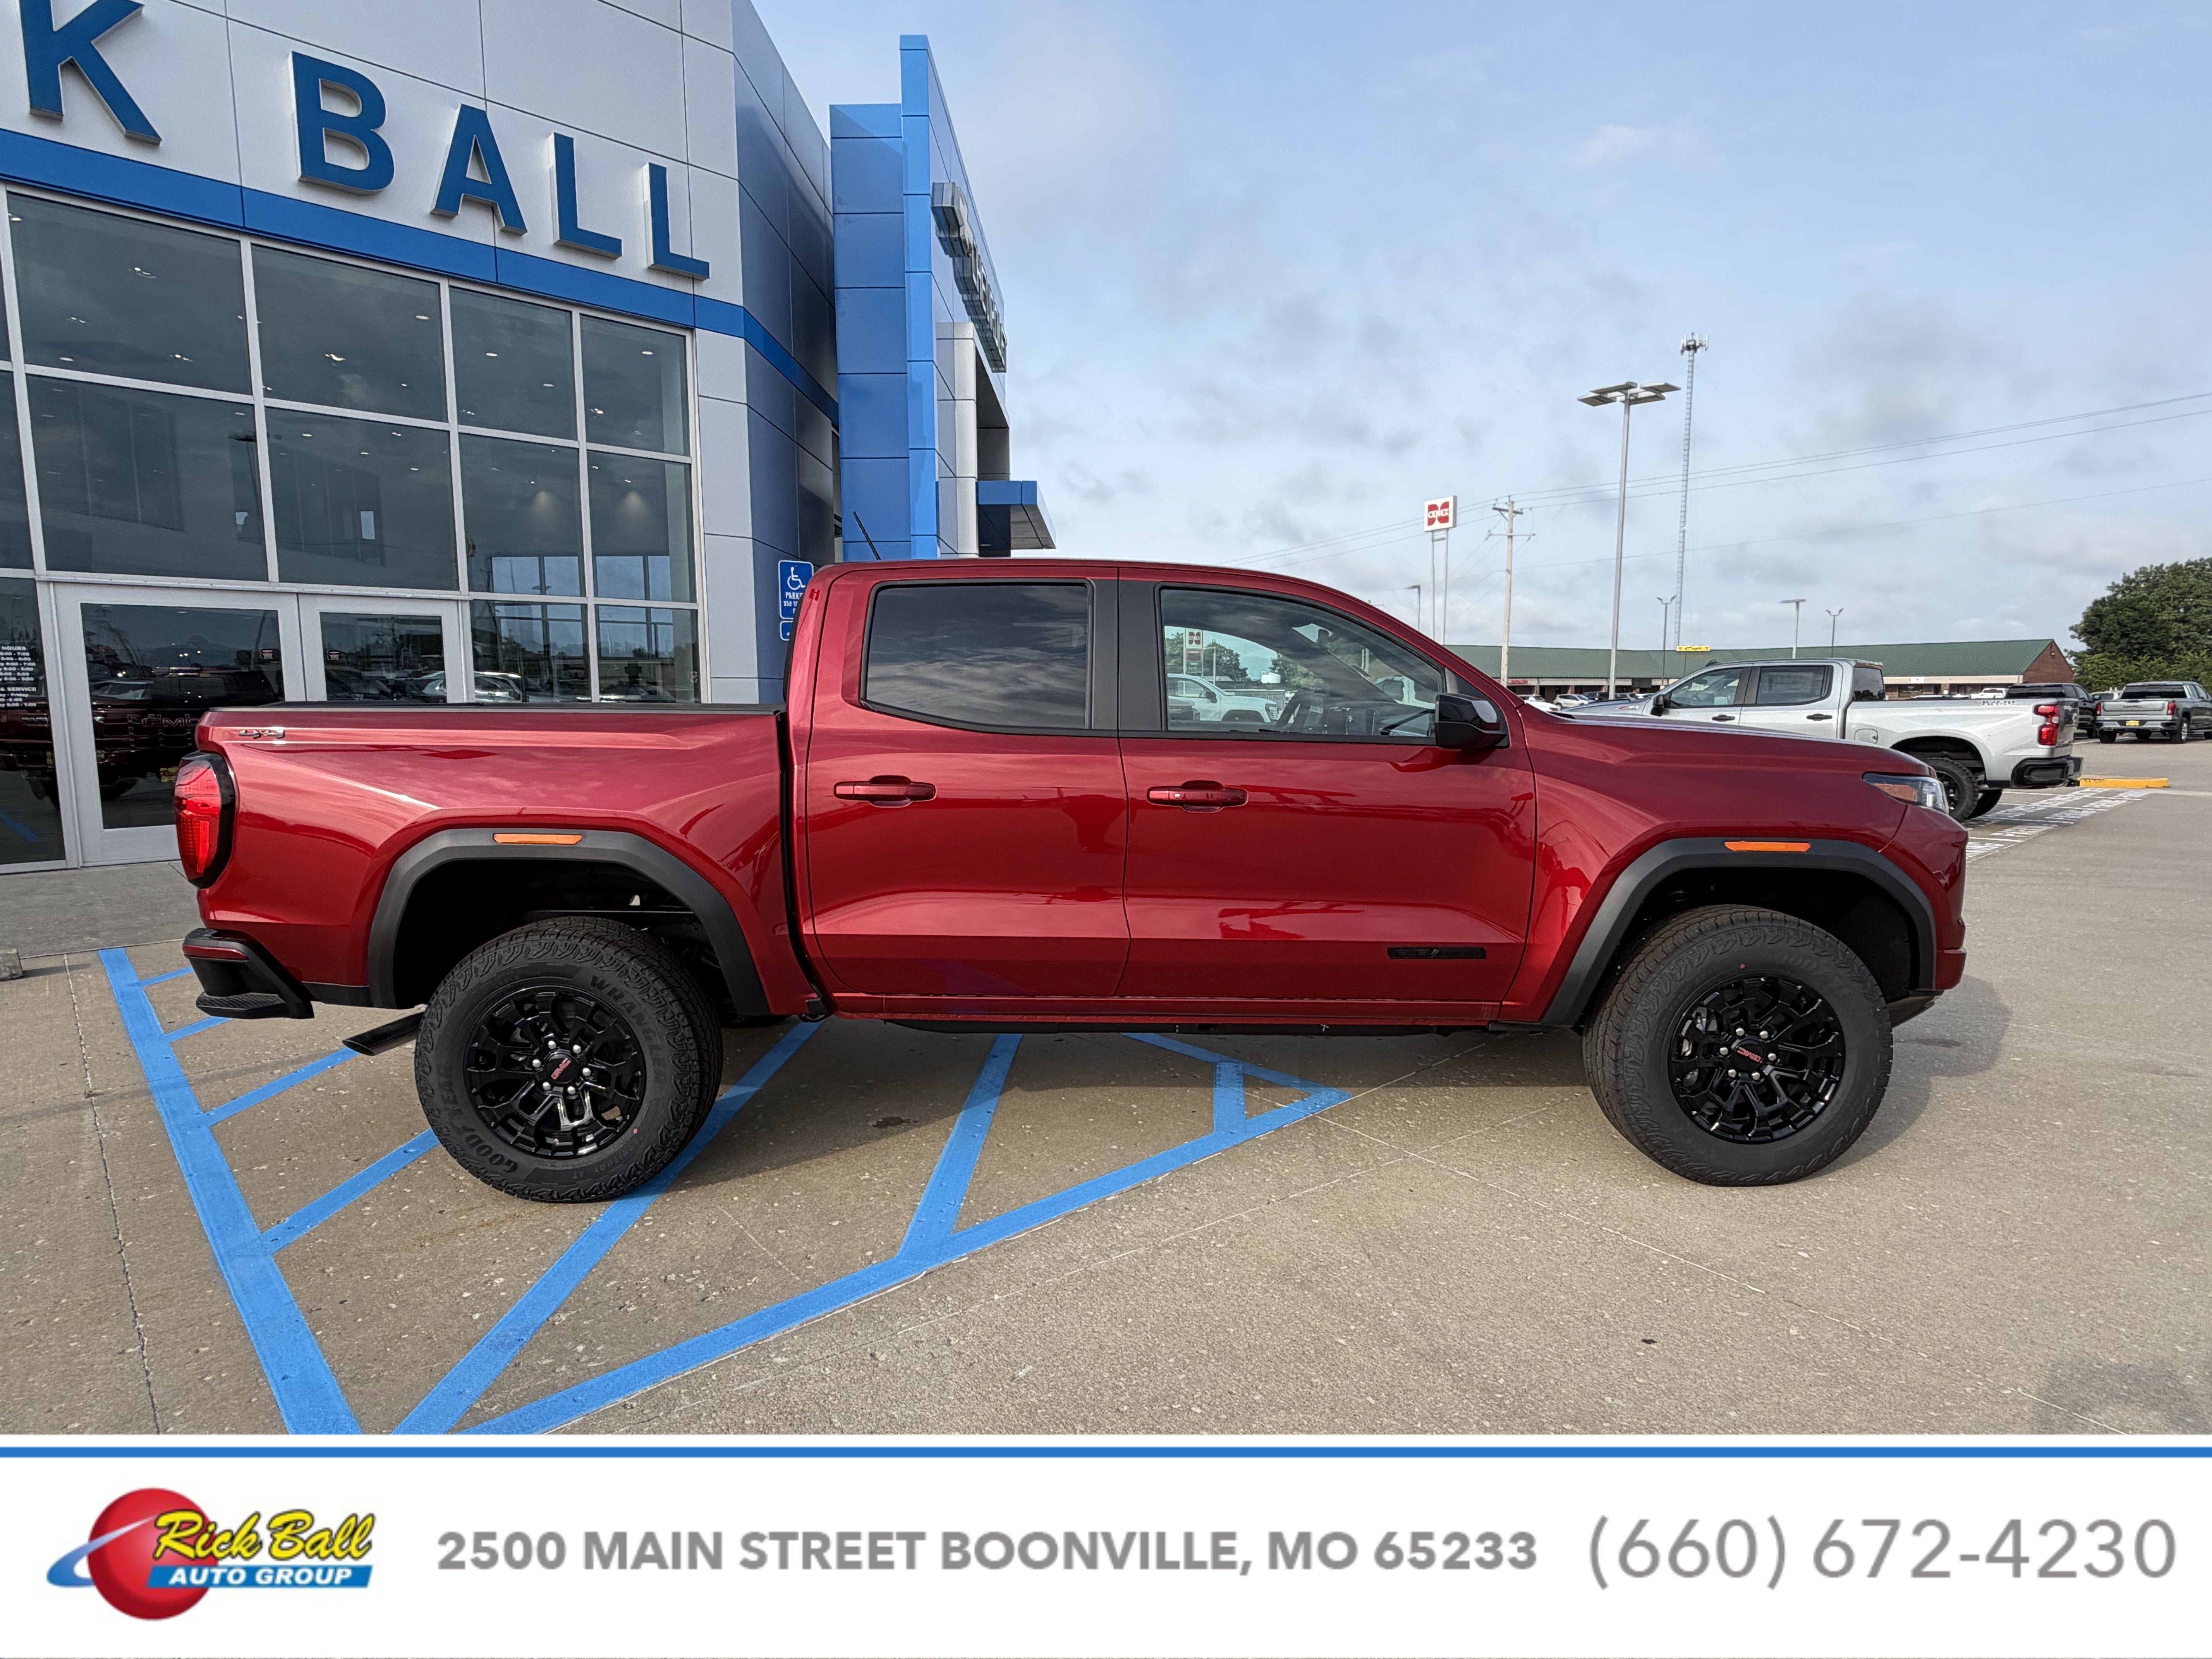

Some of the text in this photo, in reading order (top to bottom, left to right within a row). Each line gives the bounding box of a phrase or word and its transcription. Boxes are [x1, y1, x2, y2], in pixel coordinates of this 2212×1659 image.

[20, 0, 162, 146] K
[290, 51, 710, 280] BALL
[551, 1058, 571, 1080] GMC
[591, 975, 667, 1084] WRANGLER
[1737, 1046, 1762, 1063] GMC
[436, 1064, 518, 1173] GOODYEAR
